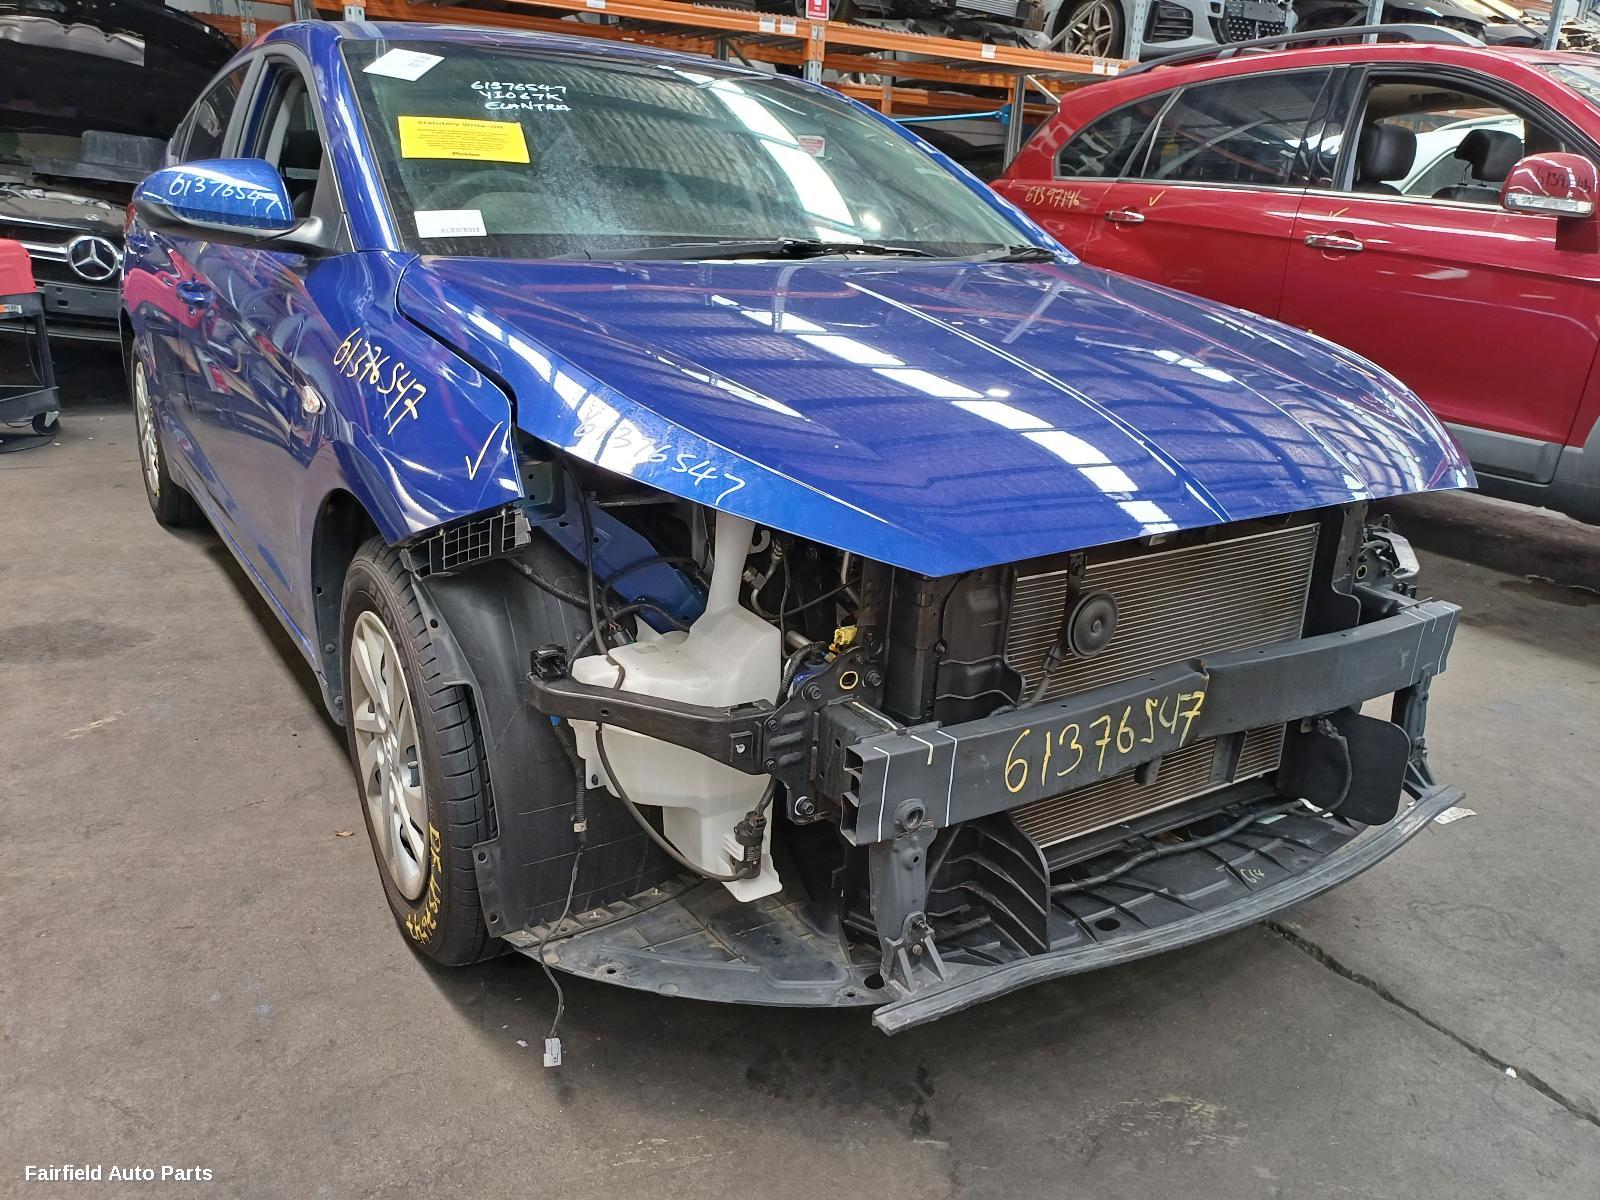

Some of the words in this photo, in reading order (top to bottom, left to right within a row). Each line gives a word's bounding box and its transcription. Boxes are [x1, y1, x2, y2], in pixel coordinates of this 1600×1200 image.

[470, 80, 567, 95] 61376547
[484, 100, 572, 112] ELANTRA
[168, 174, 279, 212] 61376547
[1025, 185, 1081, 209] 61397146
[333, 327, 427, 435] 61376547
[1004, 691, 1205, 793] 61376547
